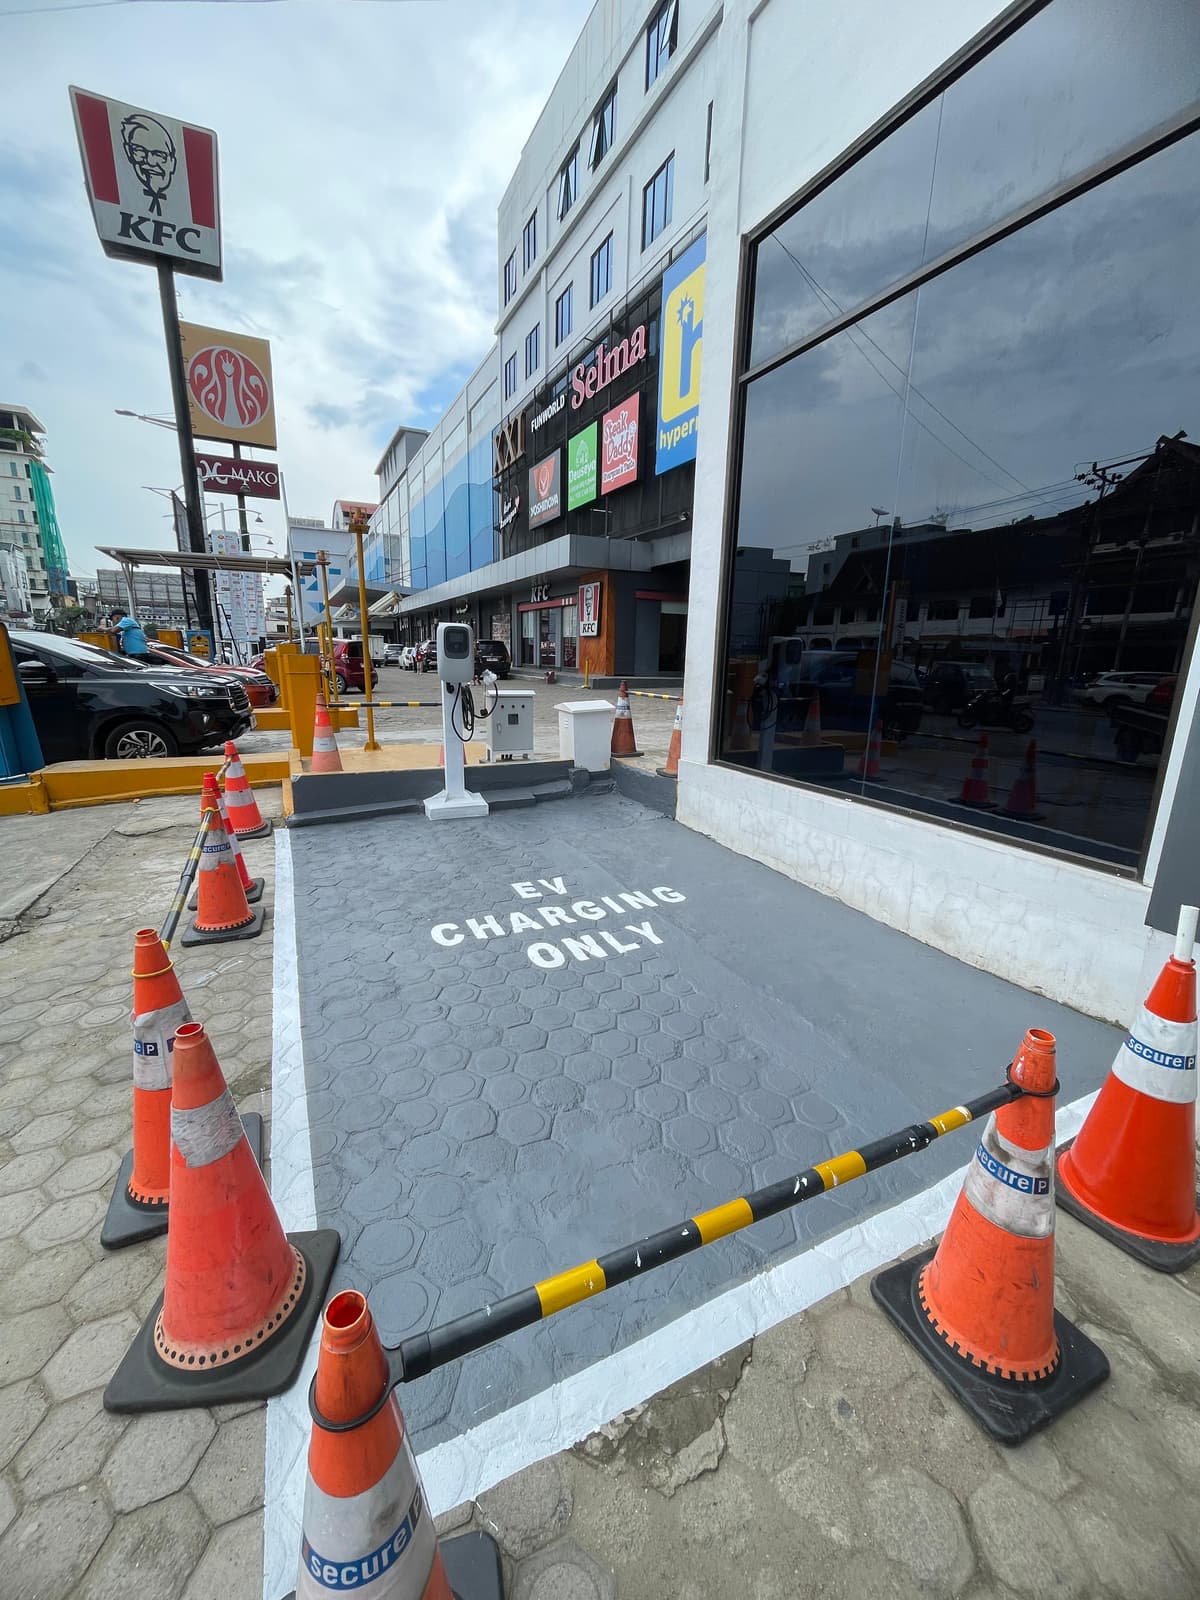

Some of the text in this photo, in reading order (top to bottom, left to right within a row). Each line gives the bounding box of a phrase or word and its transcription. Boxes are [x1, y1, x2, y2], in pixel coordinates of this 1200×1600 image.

[117, 211, 201, 254] KFC
[571, 325, 647, 410] Selma
[531, 394, 565, 433] FUNWORLD
[604, 411, 628, 444] Steak
[607, 431, 635, 465] Daddy
[660, 415, 700, 450] hyper
[231, 467, 278, 488] MAKO
[530, 584, 549, 603] KFC
[582, 623, 595, 633] KFC
[511, 876, 568, 899] EV
[430, 886, 687, 946] CHARGING
[527, 921, 664, 968] ONLY
